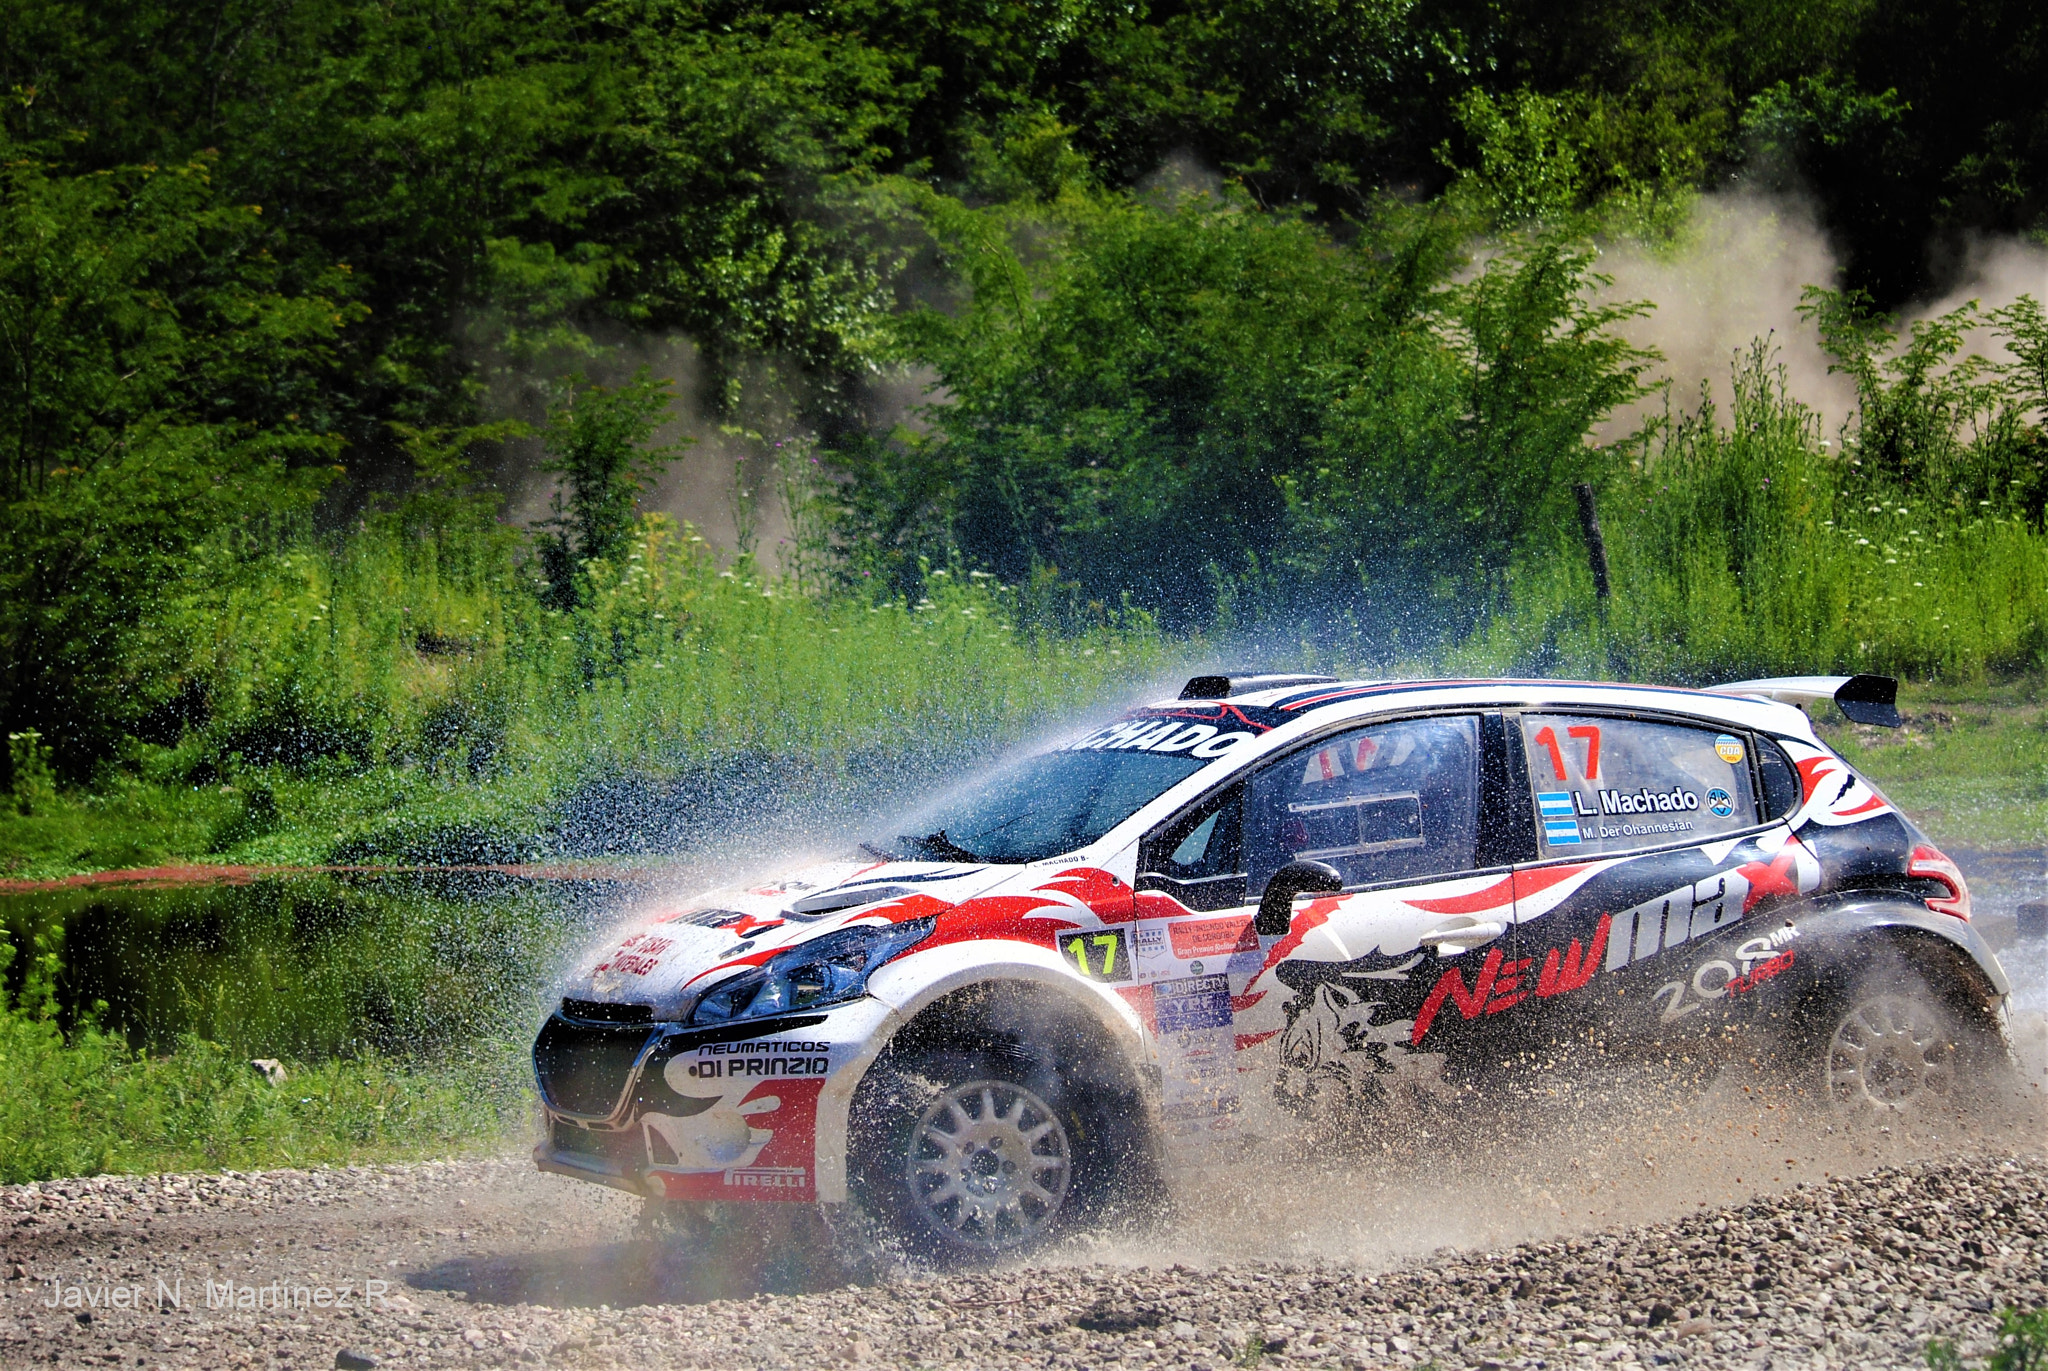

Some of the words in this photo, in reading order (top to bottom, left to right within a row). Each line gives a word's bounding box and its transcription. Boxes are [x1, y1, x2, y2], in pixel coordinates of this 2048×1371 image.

[1534, 726, 1600, 781] 17
[1573, 791, 1599, 817] L.
[1598, 785, 1700, 815] Machado
[1582, 827, 1598, 839] M.
[1600, 826, 1620, 838] Der
[1622, 820, 1694, 837] Ohannesian
[1769, 926, 1800, 947] MR
[1067, 934, 1118, 976] 17
[1724, 949, 1795, 998] TURBO
[1175, 977, 1229, 994] DIRECTV
[1172, 995, 1213, 1013] YPF
[698, 1041, 831, 1056] NEUMATICOS
[698, 1060, 722, 1078] DI
[728, 1057, 829, 1077] PRINZIO
[723, 1167, 806, 1187] PIRELLI
